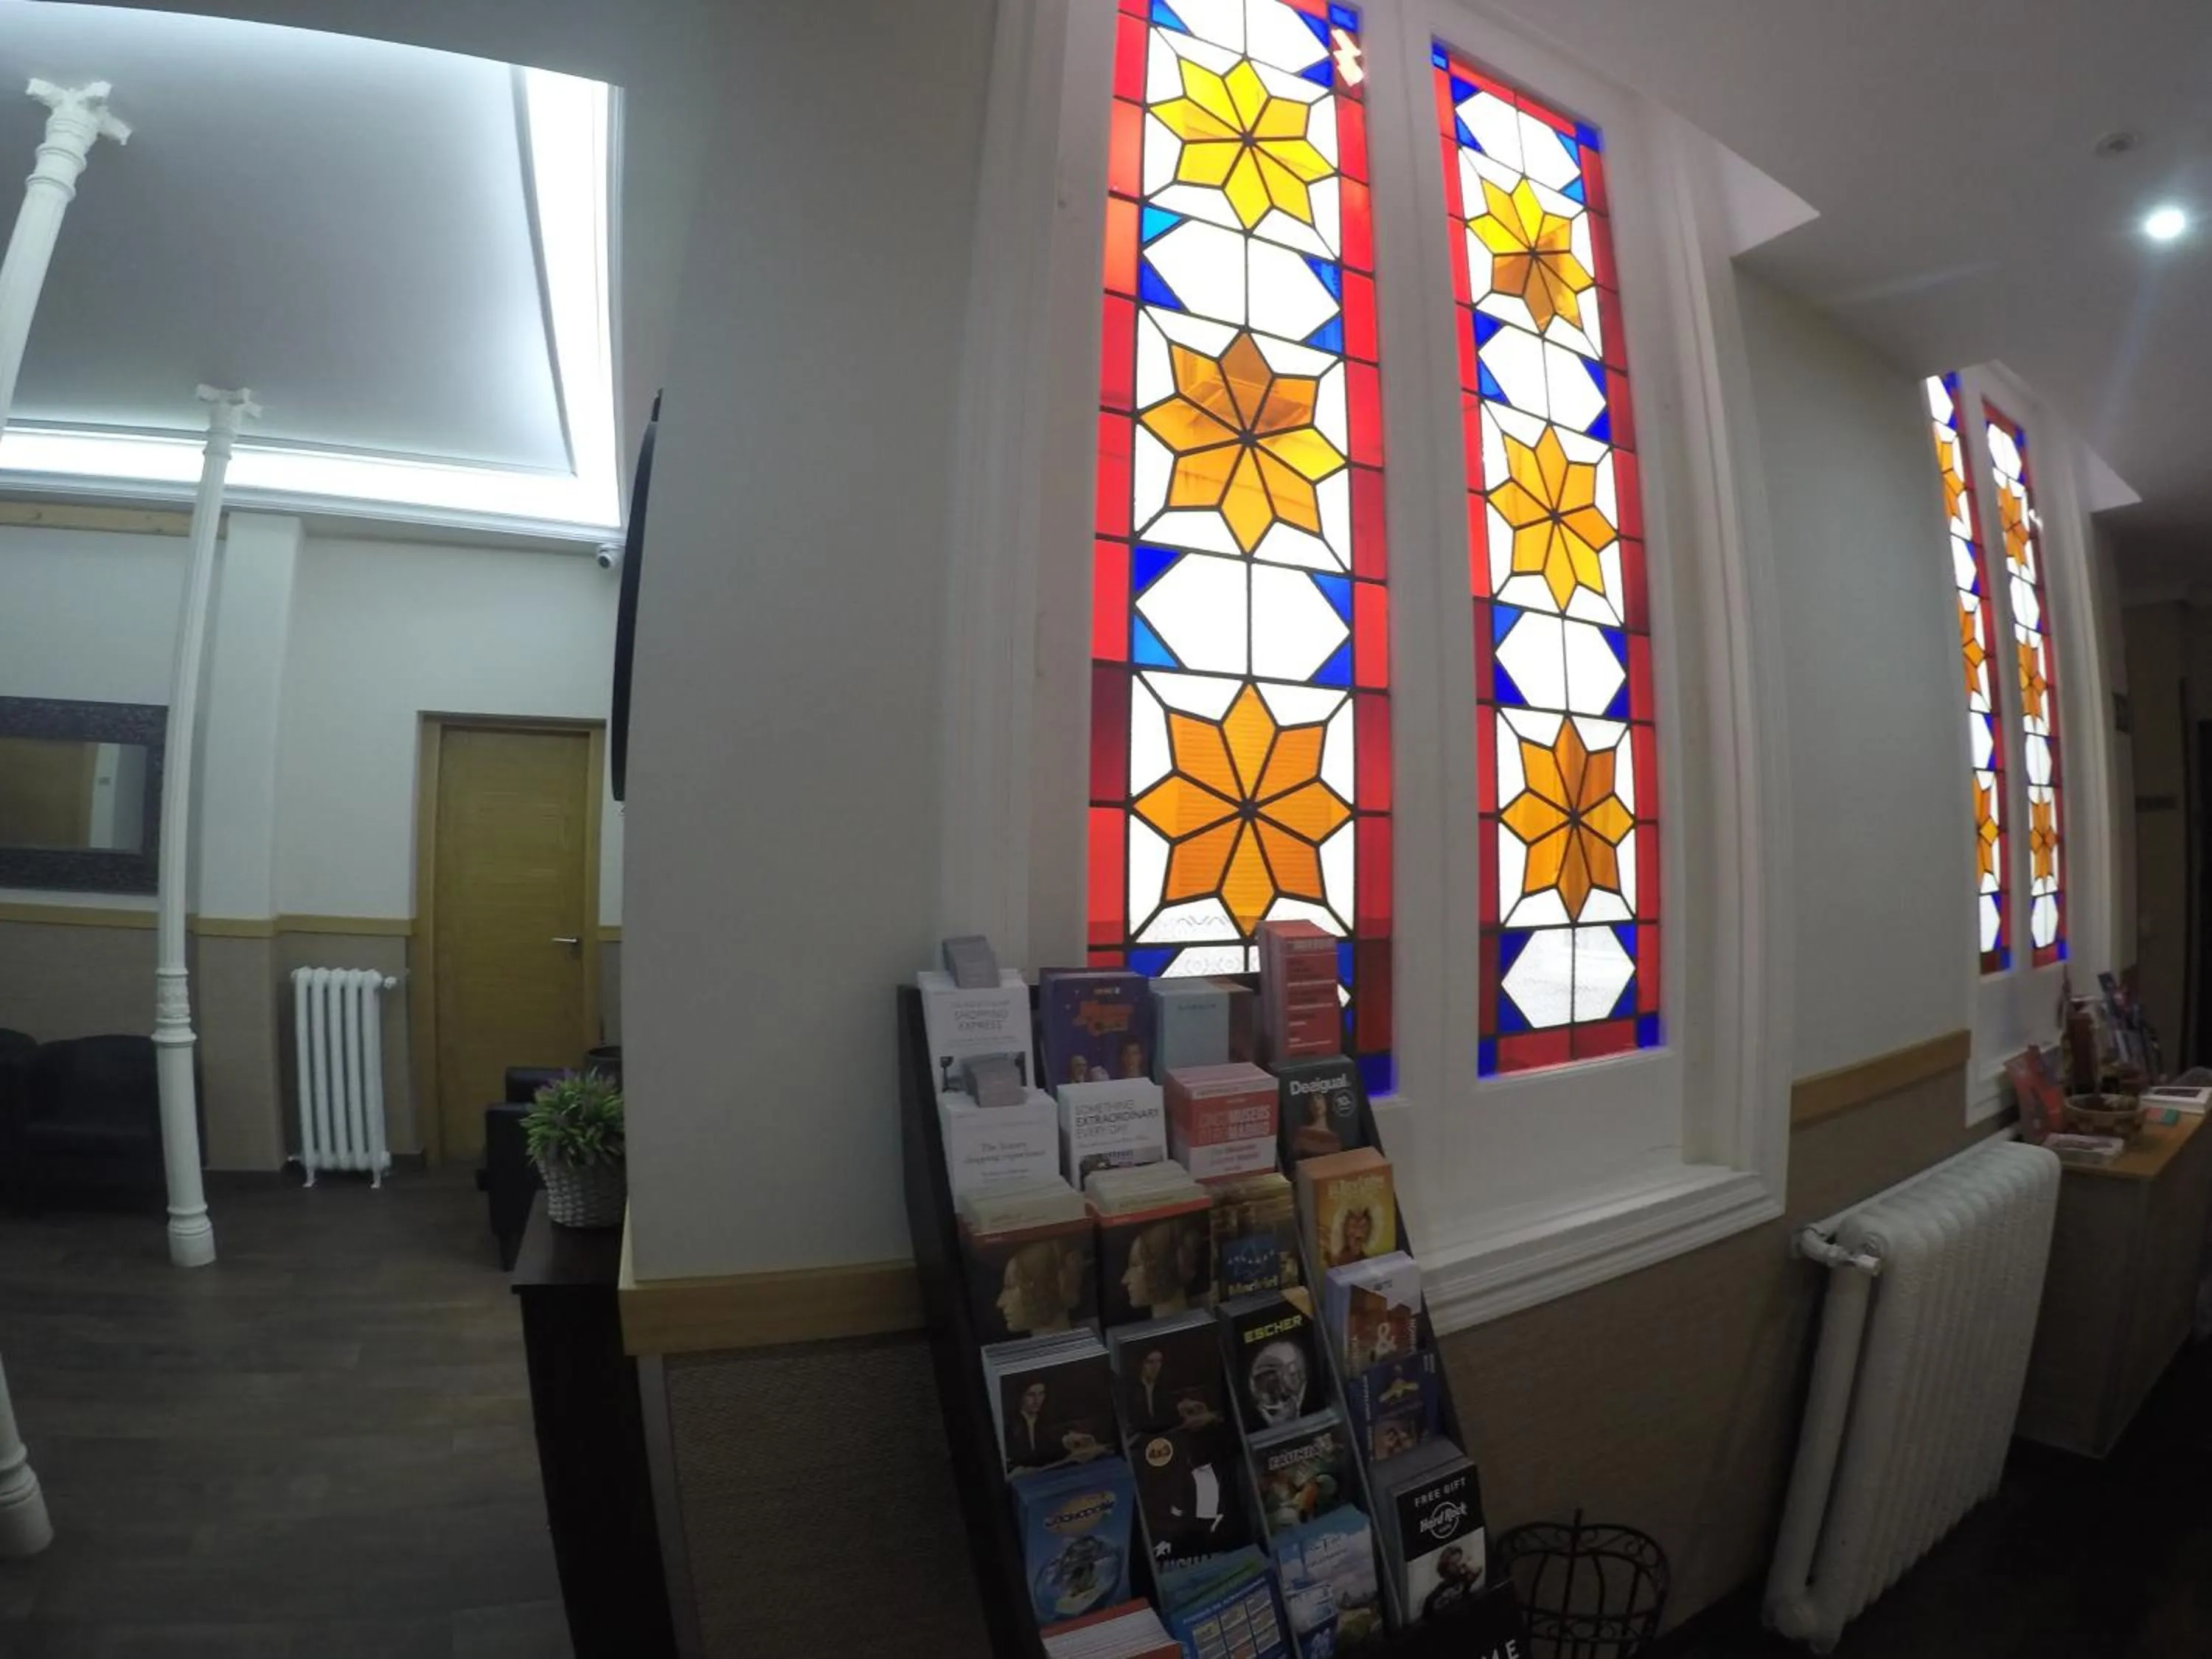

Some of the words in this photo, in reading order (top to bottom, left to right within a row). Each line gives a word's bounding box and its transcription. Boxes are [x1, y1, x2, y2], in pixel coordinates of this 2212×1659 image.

[1242, 1315, 1303, 1344] ESCHER
[1414, 1488, 1441, 1508] FREE
[1443, 1476, 1467, 1495] GIFT
[1419, 1510, 1444, 1533] Hard
